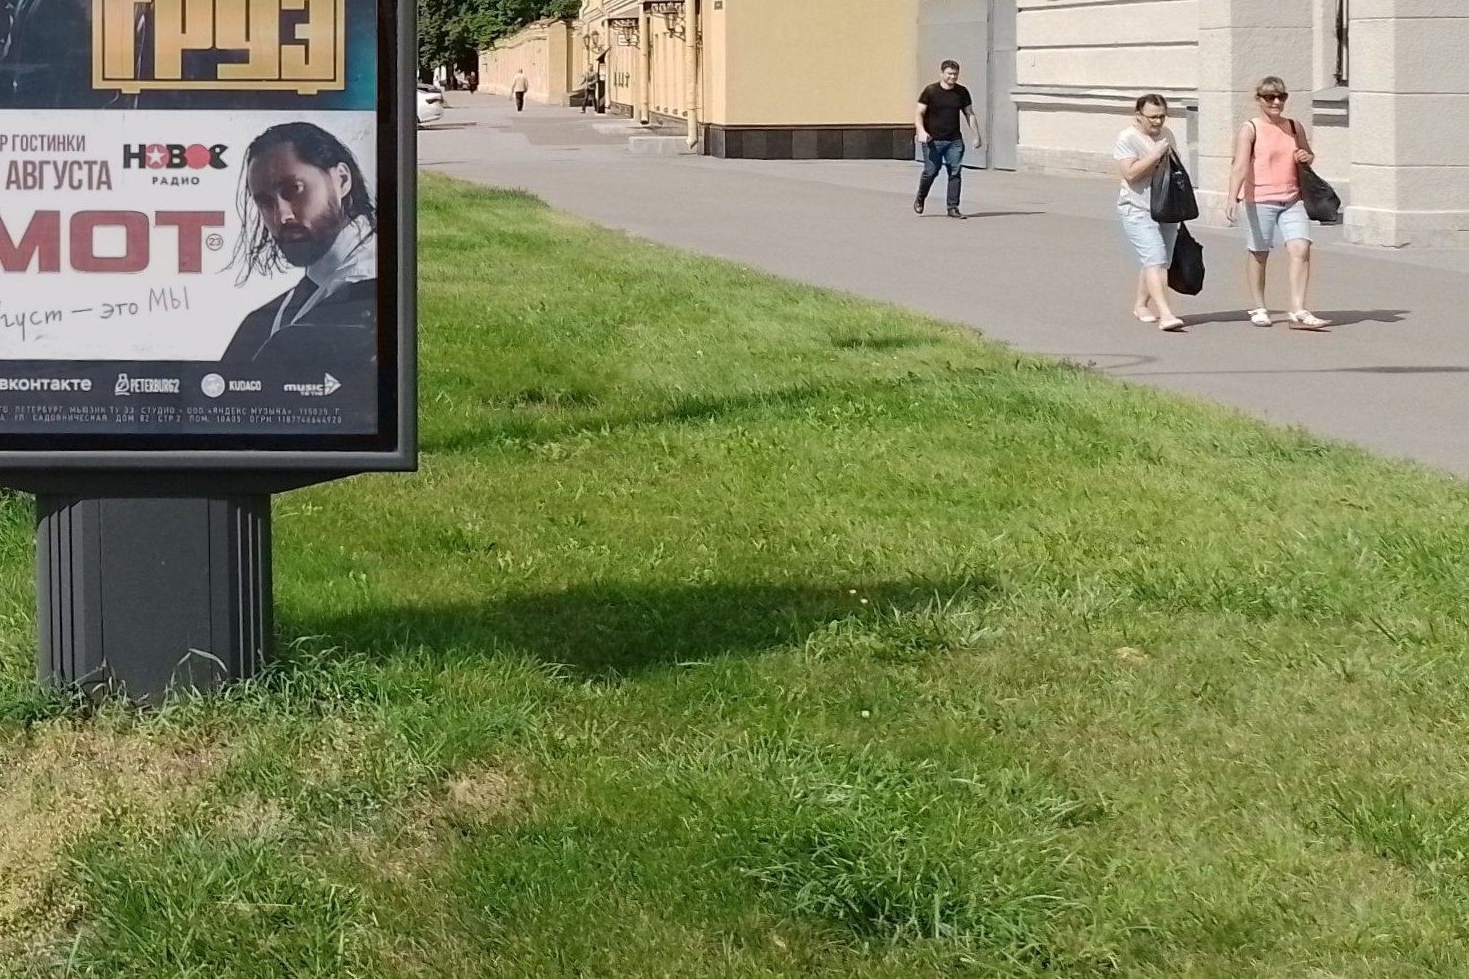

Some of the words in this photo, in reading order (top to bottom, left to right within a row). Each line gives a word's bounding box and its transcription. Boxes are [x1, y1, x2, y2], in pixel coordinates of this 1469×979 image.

[11, 133, 86, 153] ГОСТИНКИ
[5, 159, 113, 191] АВГУСТА
[152, 176, 200, 186] РАДИО
[99, 302, 139, 319] это
[148, 286, 190, 313] МЫ
[228, 380, 262, 392] KUDAGO
